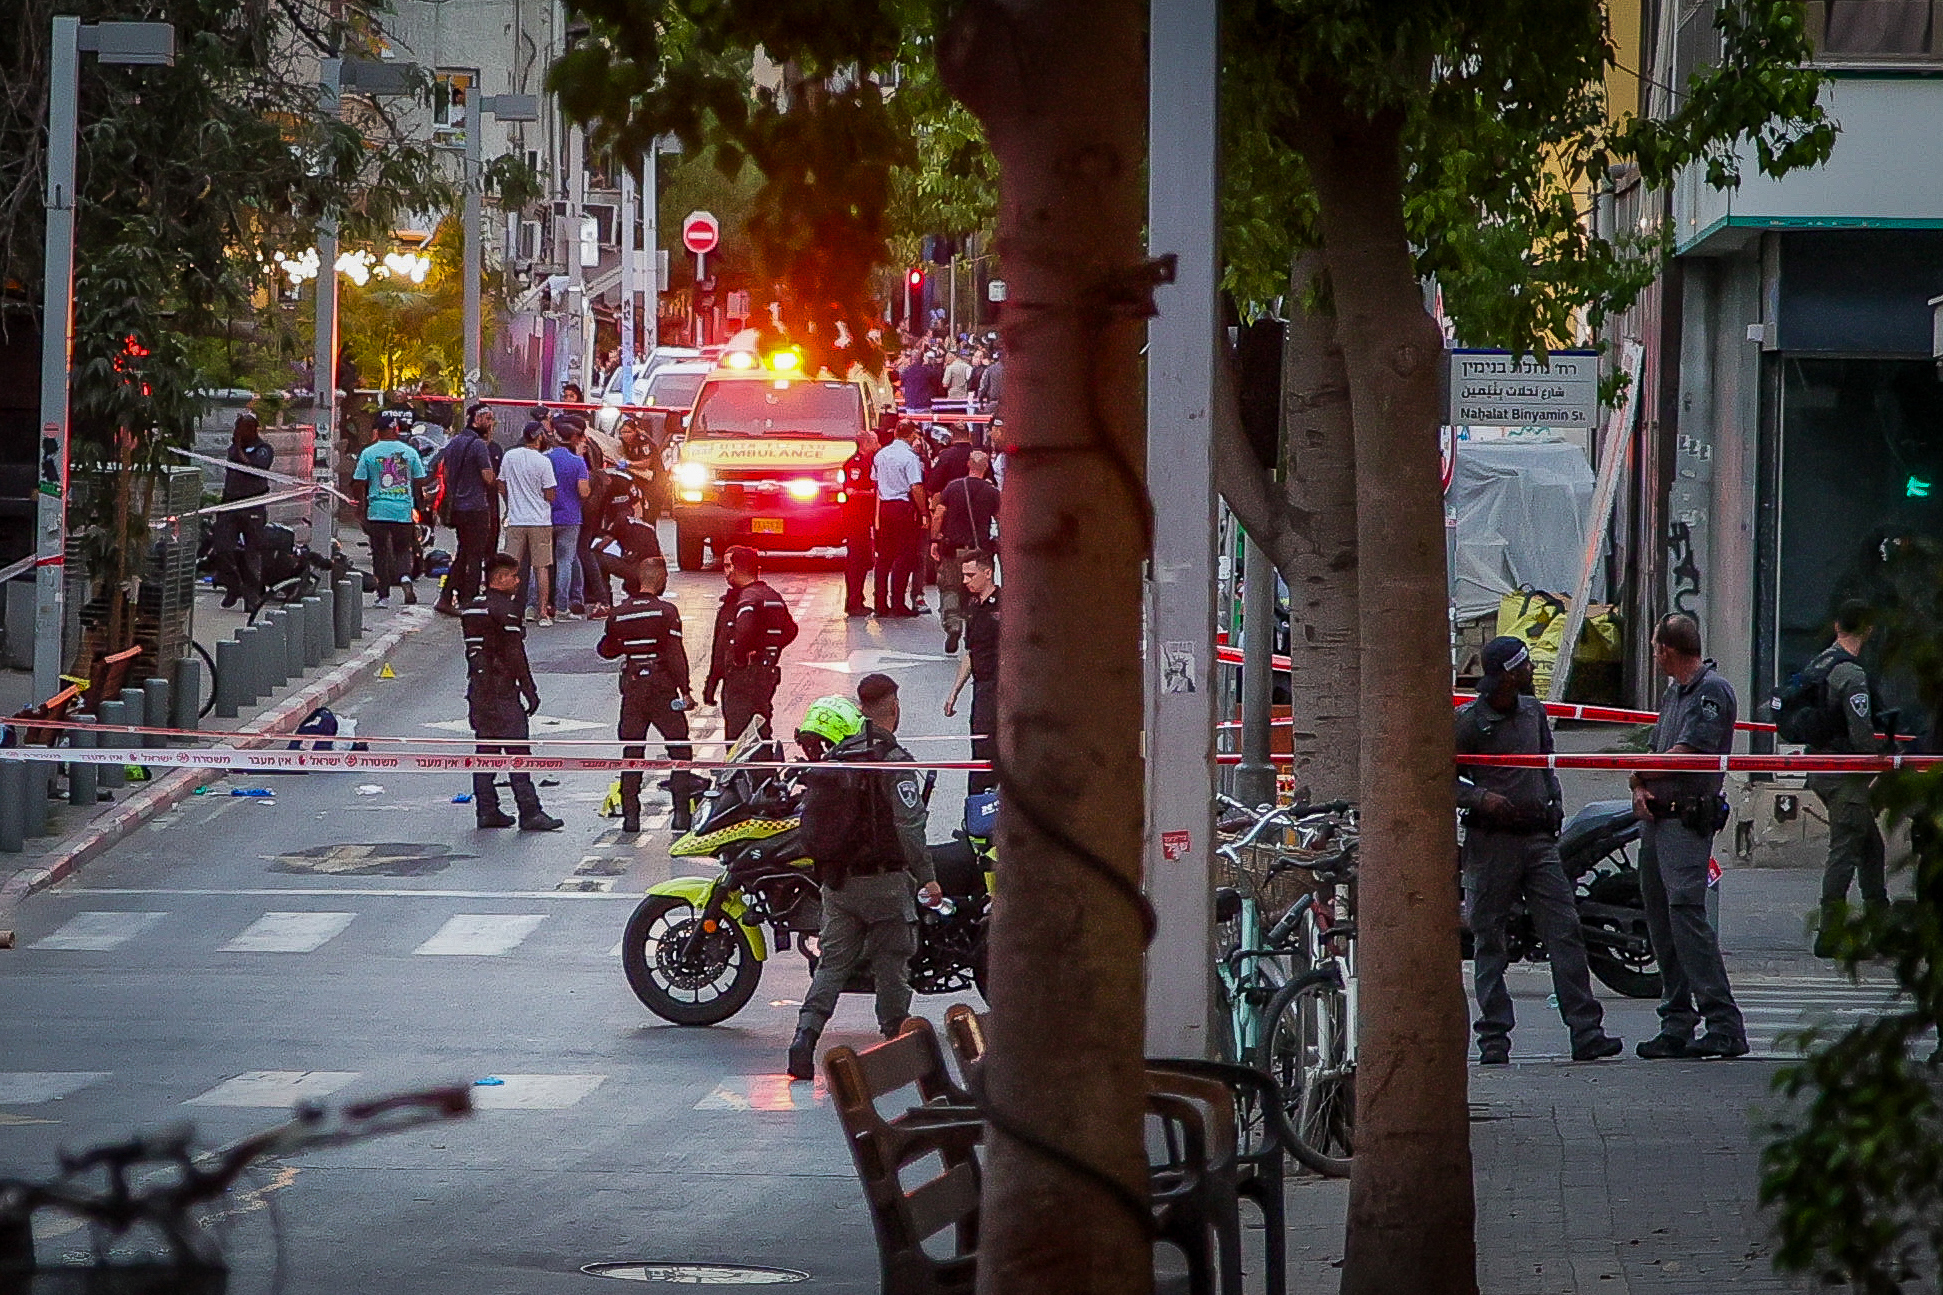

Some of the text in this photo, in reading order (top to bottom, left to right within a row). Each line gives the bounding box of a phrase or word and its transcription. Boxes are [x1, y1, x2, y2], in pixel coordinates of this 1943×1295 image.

[1461, 361, 1507, 377] בנימין
[1540, 386, 1565, 400] شارع
[1512, 408, 1569, 423] Binyamin
[1571, 411, 1586, 421] St.
[719, 450, 824, 458] AMBULANCE
